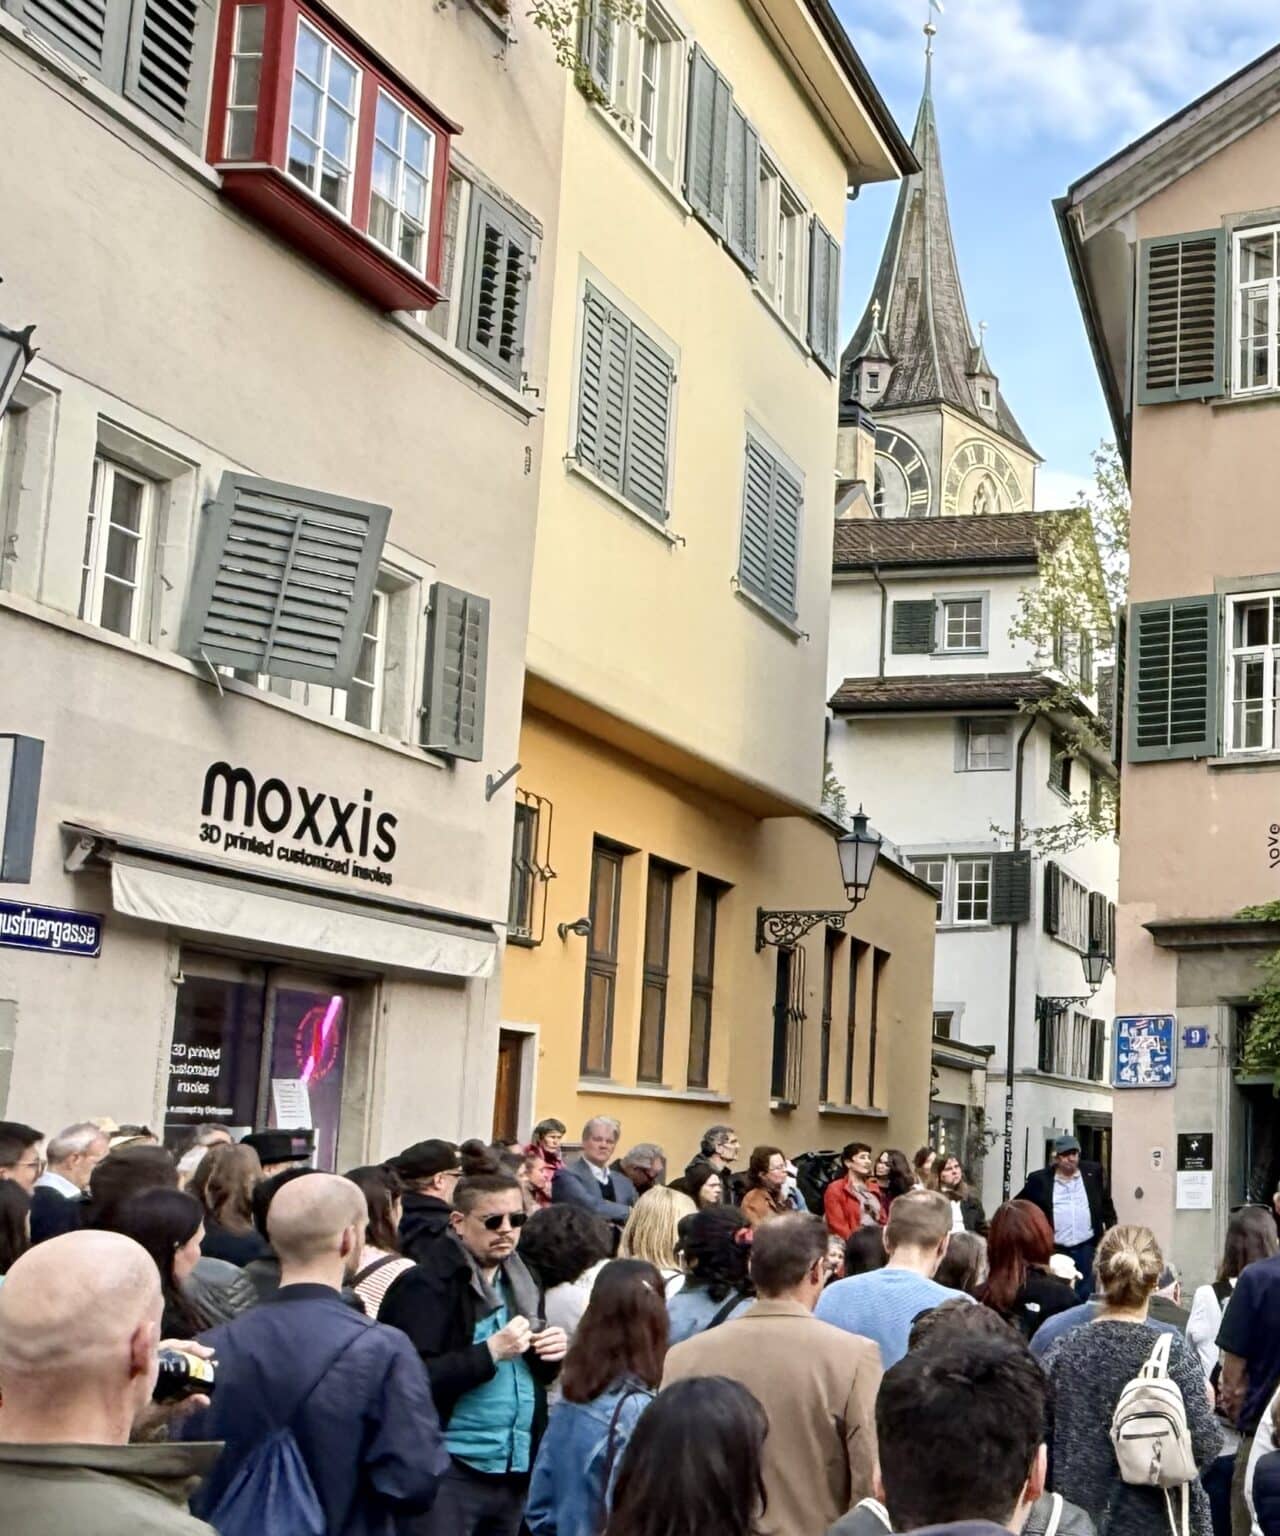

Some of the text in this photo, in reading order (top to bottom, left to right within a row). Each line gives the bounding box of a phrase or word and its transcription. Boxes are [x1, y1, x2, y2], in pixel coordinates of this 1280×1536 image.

[201, 761, 398, 862] moxxis
[199, 823, 393, 886] 3D printed customized insoles
[1191, 1030, 1201, 1044] 9
